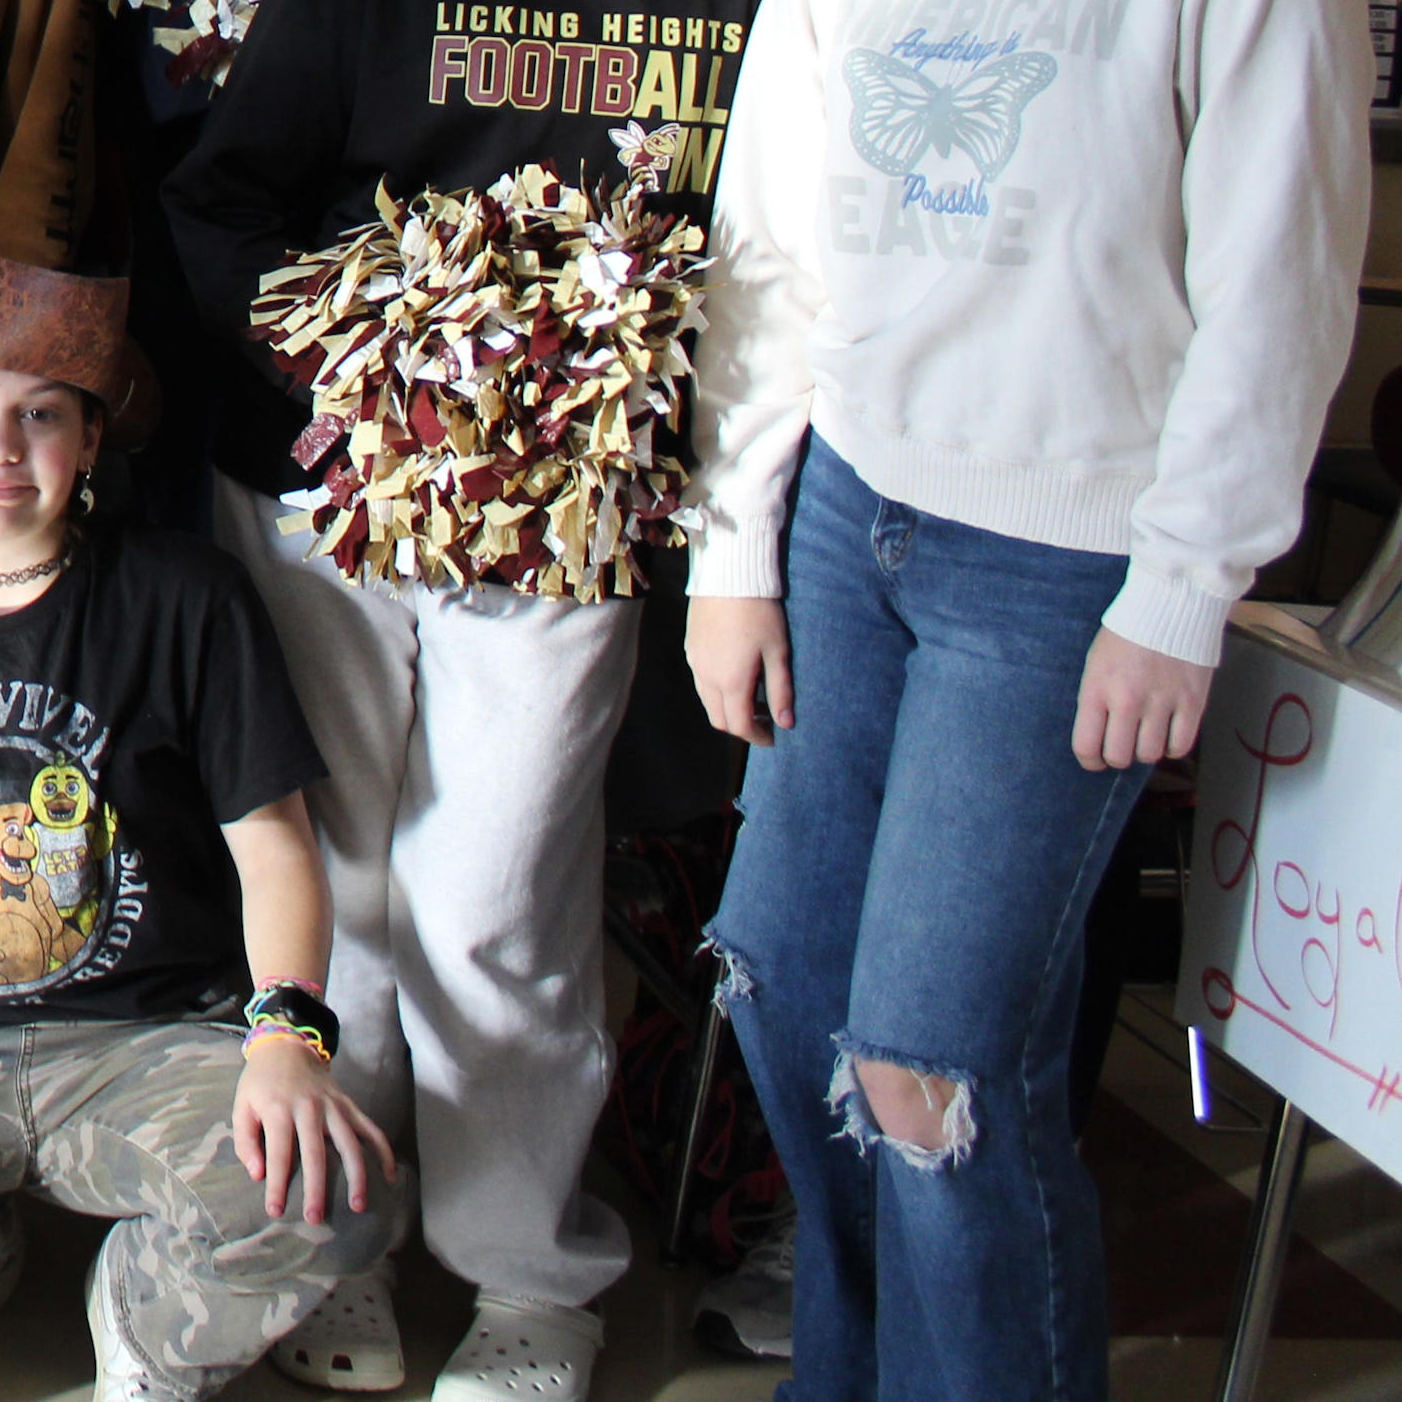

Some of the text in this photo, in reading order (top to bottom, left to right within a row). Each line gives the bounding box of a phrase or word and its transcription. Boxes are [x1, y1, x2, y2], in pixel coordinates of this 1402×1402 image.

[436, 1, 743, 54] LICKING HEIGHTS
[428, 34, 730, 124] FOOTBALL
[901, 172, 990, 217] Possible
